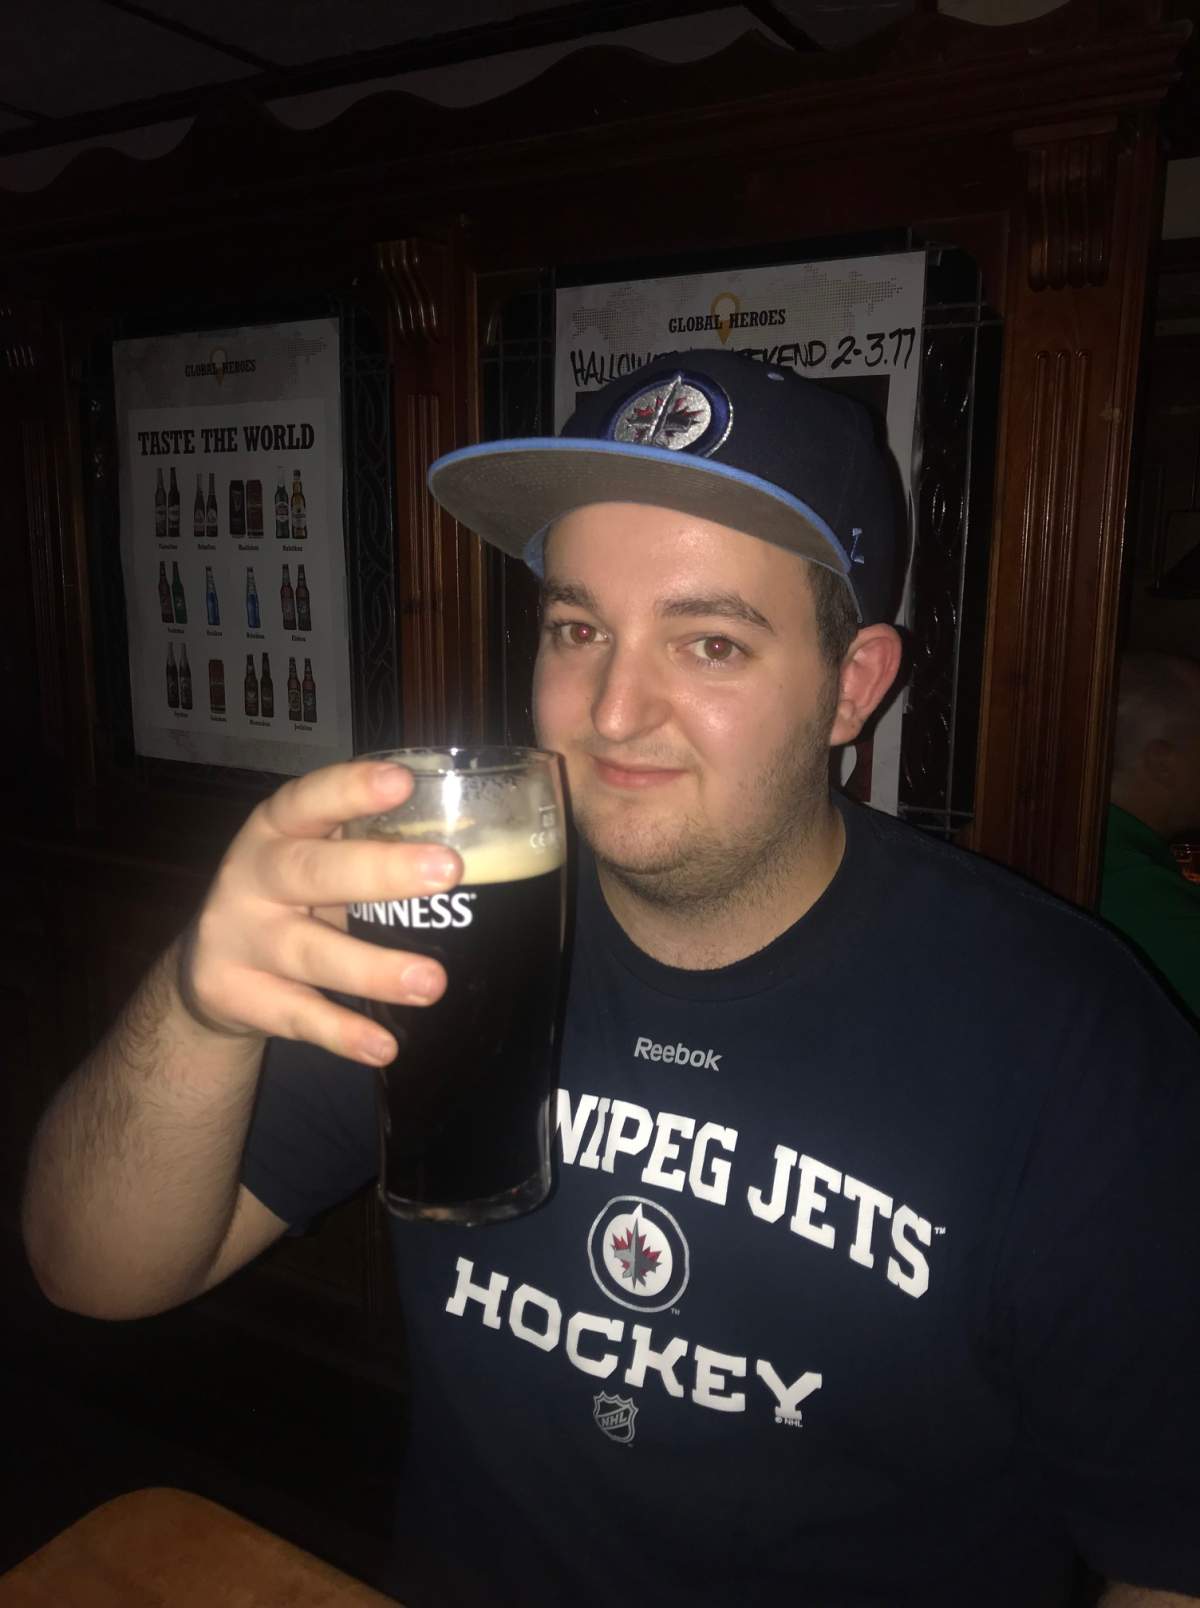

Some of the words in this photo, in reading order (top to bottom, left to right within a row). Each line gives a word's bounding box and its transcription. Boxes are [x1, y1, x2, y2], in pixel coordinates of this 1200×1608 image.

[668, 312, 723, 333] GLOBAL
[728, 308, 787, 328] HEROES
[184, 360, 218, 378] GLOBAL
[222, 358, 257, 375] HEROES
[137, 429, 195, 456] TASTE
[200, 426, 239, 453] THE
[242, 422, 316, 452] WORLD
[633, 1036, 723, 1072] Reebok
[555, 1087, 738, 1206] NIPEG
[746, 1143, 933, 1299] JETS
[445, 1256, 823, 1420] HOCKEY
[600, 1410, 628, 1429] NHL
